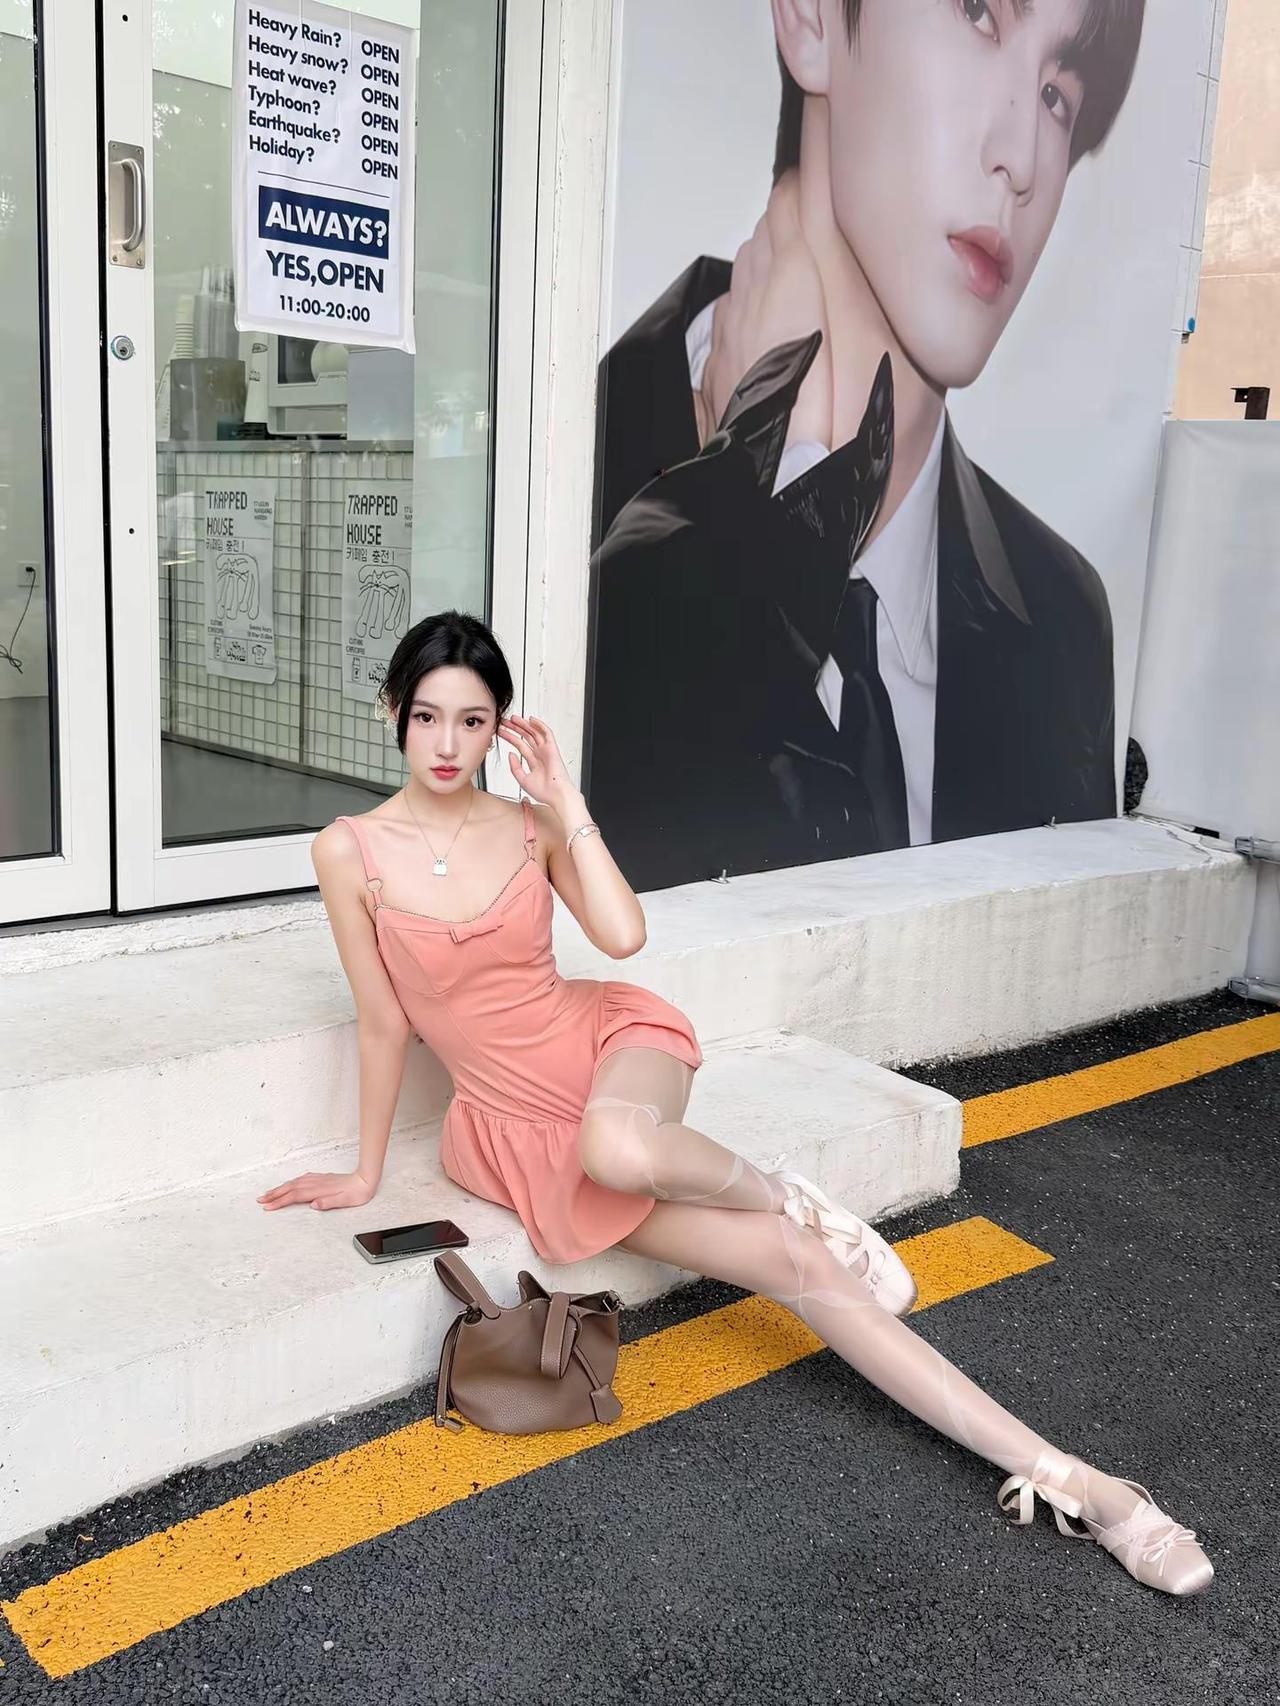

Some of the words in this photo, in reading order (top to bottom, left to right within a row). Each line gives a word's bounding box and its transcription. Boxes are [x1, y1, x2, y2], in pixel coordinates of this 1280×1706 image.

[248, 9, 298, 40] Heavy
[301, 23, 342, 48] Rain?
[361, 40, 400, 64] OPEN
[248, 34, 298, 65] Heavy
[301, 52, 348, 74] snow?
[361, 64, 399, 87] OPEN
[248, 60, 285, 82] Heat
[288, 73, 337, 95] wave?
[361, 87, 399, 110] OPEN
[248, 84, 321, 116] Typhoon?
[361, 111, 399, 134] OPEN
[248, 109, 341, 144] Earthquake?
[361, 134, 399, 157] OPEN
[249, 134, 315, 165] Holiday?
[361, 158, 399, 180] OPEN
[265, 201, 388, 248] ALWAYS?
[265, 249, 385, 293] YES,OPEN
[279, 295, 371, 323] 11:00-20:00
[206, 490, 248, 510] TRAPPED
[348, 494, 398, 516] TRAPPED
[206, 517, 234, 536] HOUSE
[346, 523, 382, 545] HOUSE
